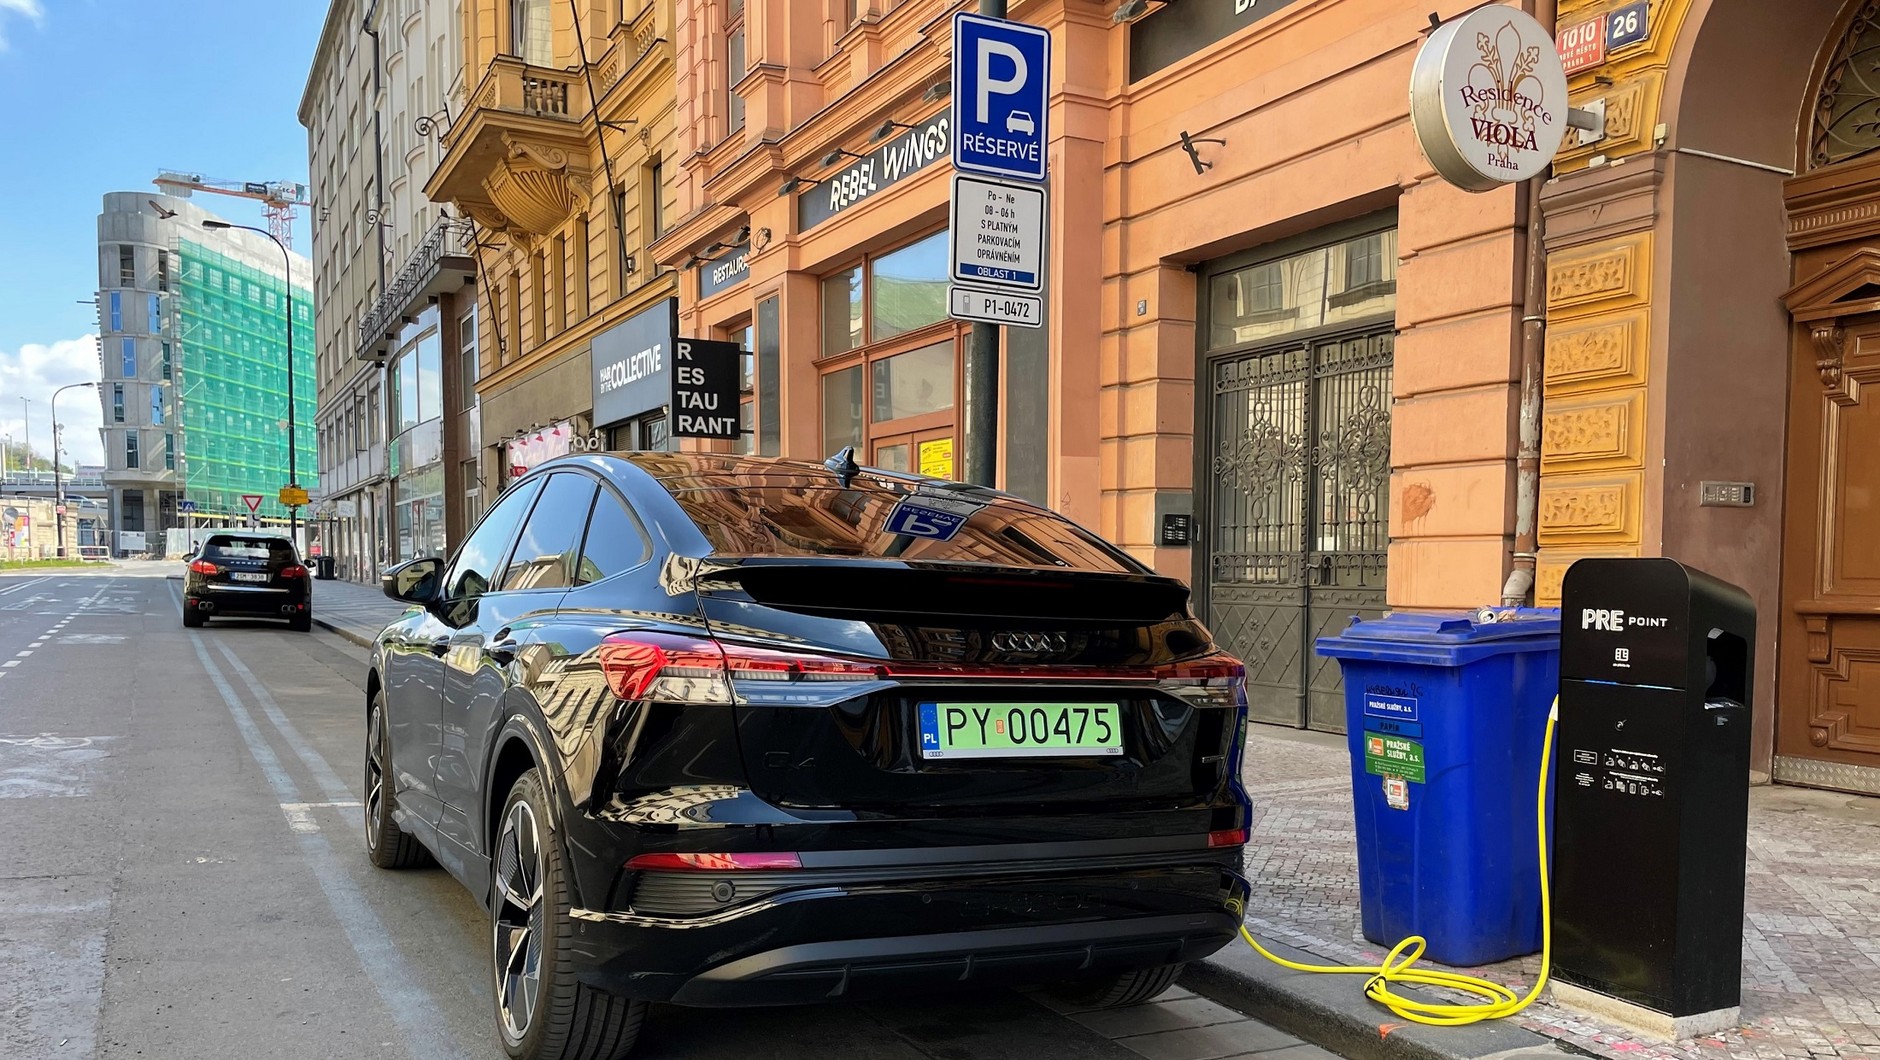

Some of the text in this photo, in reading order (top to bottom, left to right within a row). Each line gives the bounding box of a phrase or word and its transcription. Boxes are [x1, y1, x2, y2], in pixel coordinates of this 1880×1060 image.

[1612, 10, 1638, 39] 26
[1562, 21, 1596, 51] 1010
[1563, 53, 1593, 70] PRAHA 1
[976, 37, 1028, 124] P
[1458, 80, 1552, 126] Residence
[1469, 117, 1539, 152] VIOLA
[963, 132, 1039, 162] RÉSERVÉ
[829, 118, 949, 212] REBEL WINGS
[1487, 152, 1519, 171] Praha
[988, 190, 997, 201] Po
[1006, 193, 1015, 204] Ne
[984, 204, 994, 216] 08
[1000, 207, 1009, 218] 06
[1010, 209, 1015, 219] h
[980, 219, 1018, 234] S PLATNÝM
[977, 233, 1021, 249] PARKOVACÍM
[976, 248, 1020, 263] OPRÁVNĚNÍM
[977, 266, 1017, 280] OBLAST 1
[984, 298, 1030, 318] P1-0472
[677, 342, 692, 361] R
[611, 344, 662, 389] COLLECTIVE
[677, 367, 705, 386] ES
[677, 391, 718, 410] TAU
[678, 415, 736, 436] RANT
[1581, 608, 1668, 632] PRE POINT
[946, 707, 1112, 746] PY 00475
[923, 733, 937, 744] PL
[1386, 739, 1411, 752] PRAŽSKÉ
[1386, 749, 1408, 762] SLUŽBY,
[1409, 753, 1420, 763] a.s.
